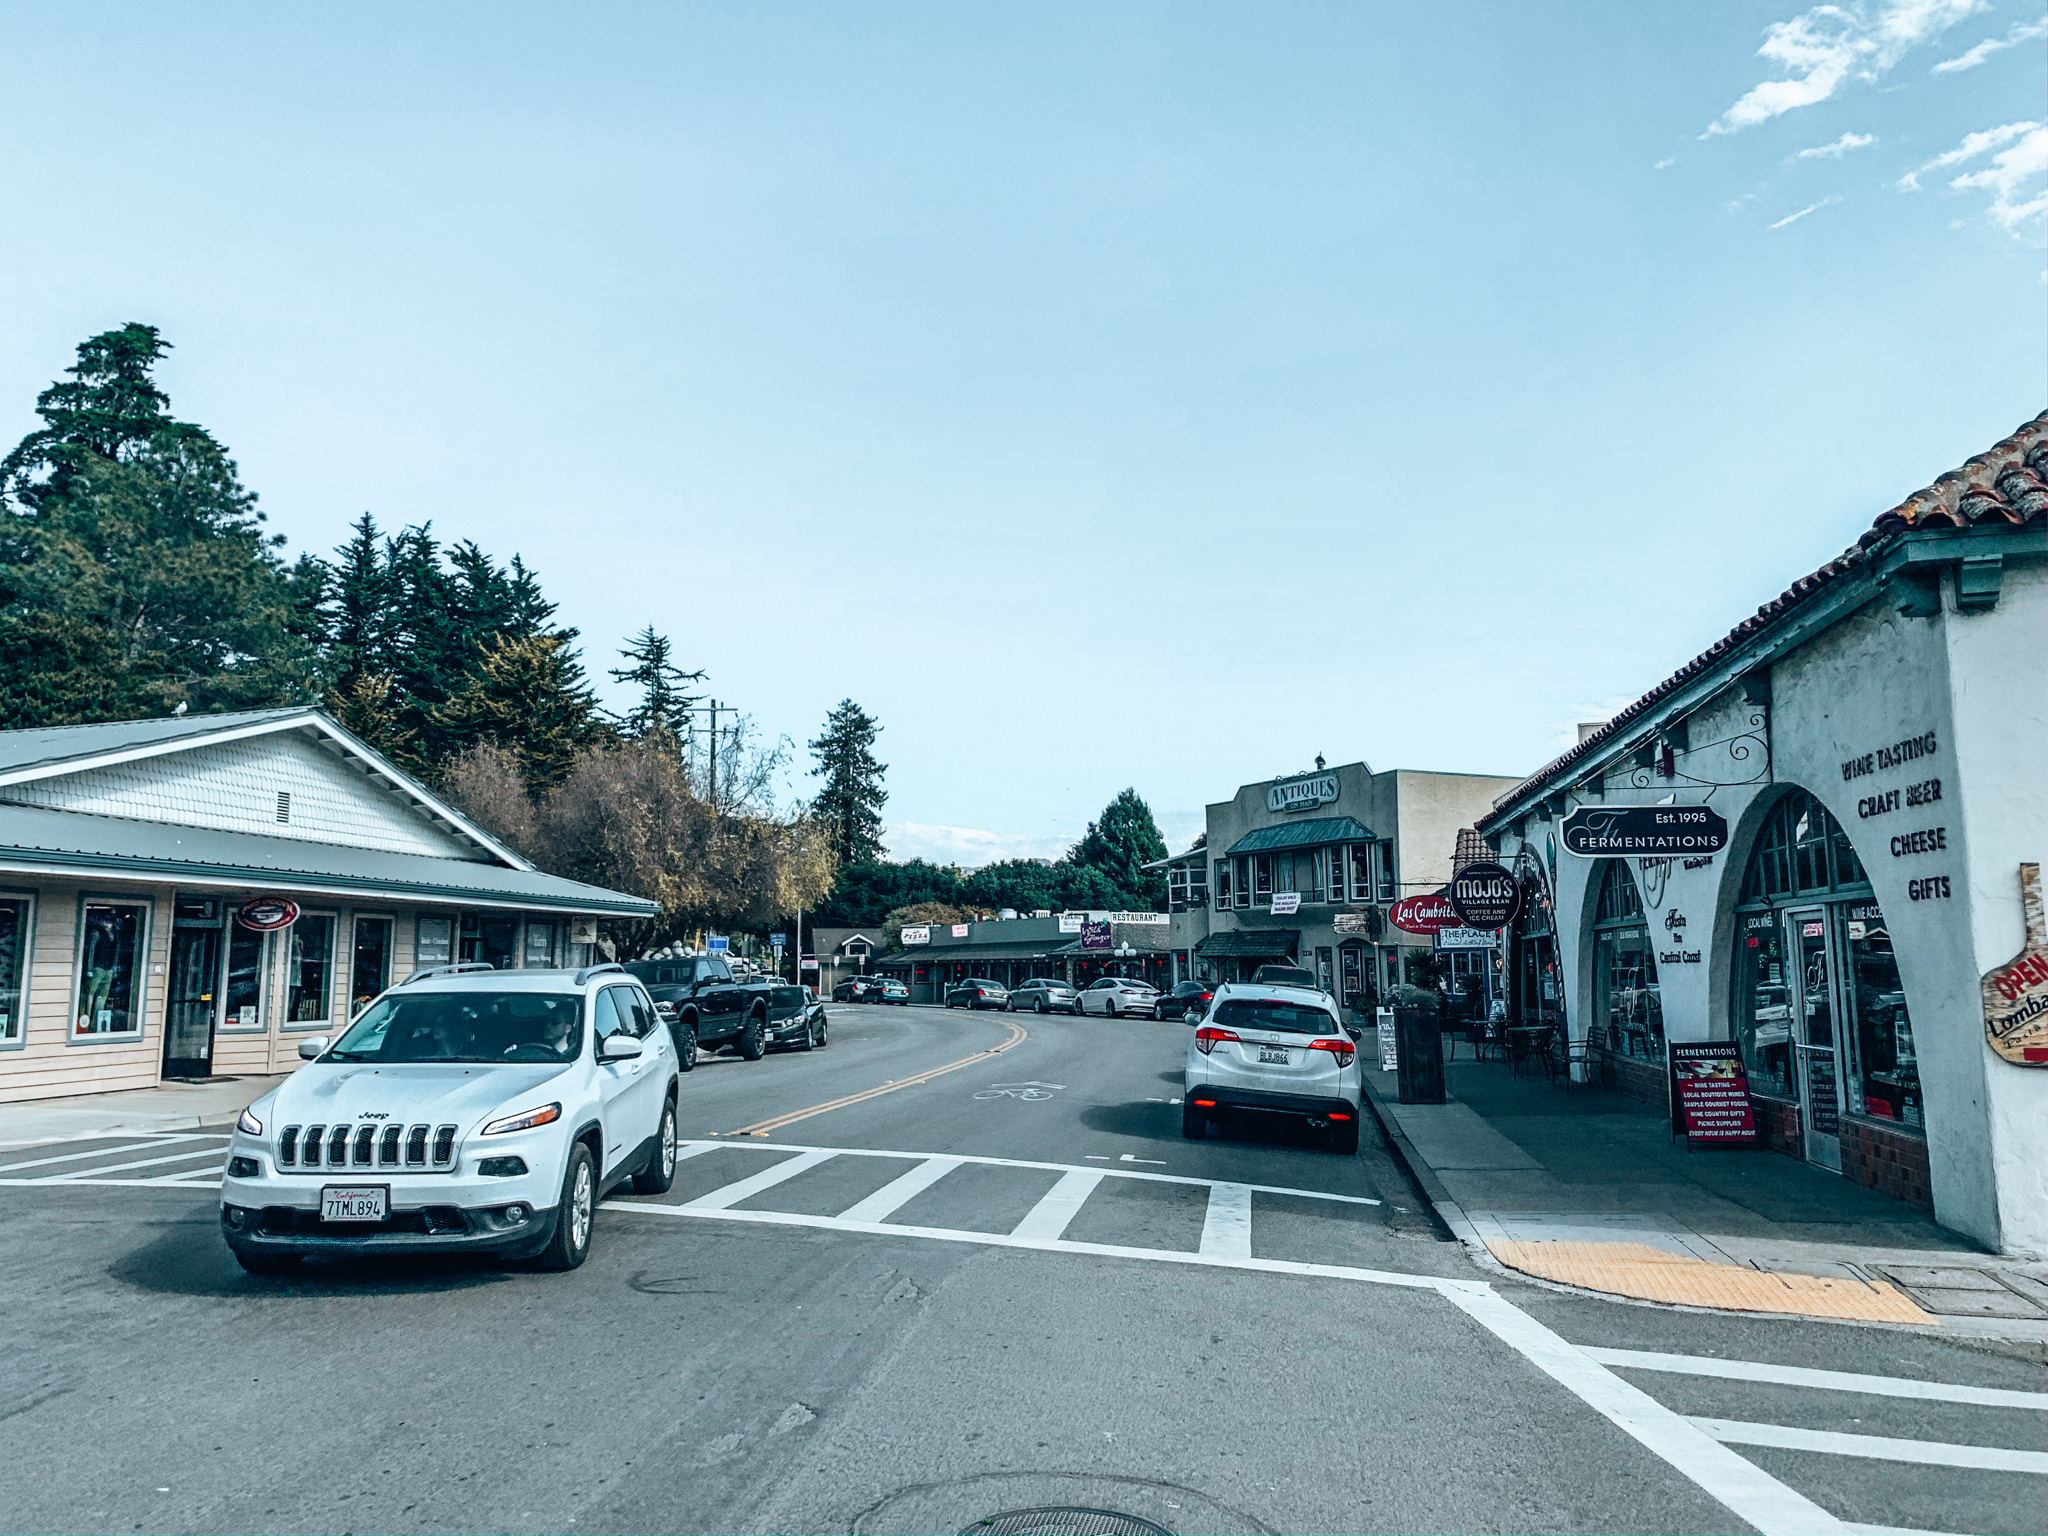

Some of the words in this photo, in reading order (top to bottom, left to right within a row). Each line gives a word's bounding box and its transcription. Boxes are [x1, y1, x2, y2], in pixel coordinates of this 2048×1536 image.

[1841, 753, 1874, 781] WINE
[1876, 731, 1937, 770] TASTING
[1271, 778, 1335, 806] ANTIQUES
[1858, 789, 1900, 819] CRAFT
[1906, 778, 1942, 807] BEER
[1656, 813, 1676, 824] Est.
[1679, 813, 1707, 823] 1995
[1579, 835, 1719, 848] FERMENTATIONS
[1890, 827, 1946, 857] CHEESE
[1456, 876, 1513, 899] MOJO'S
[1909, 876, 1951, 901] GIFTS
[1113, 914, 1158, 922] RESTAURANT
[1396, 903, 1413, 924] Las
[1852, 907, 1865, 920] WINE
[1748, 918, 1761, 929] LOCAL
[1444, 930, 1460, 939] THE
[1461, 929, 1491, 938] PLACE
[1682, 950, 1702, 964] Coast
[1995, 953, 2048, 1001] OPEN
[1676, 1048, 1737, 1057] FERMENTATIONS
[358, 1111, 389, 1120] Jeep
[335, 1191, 373, 1200] California
[327, 1200, 381, 1216] 7TML894
